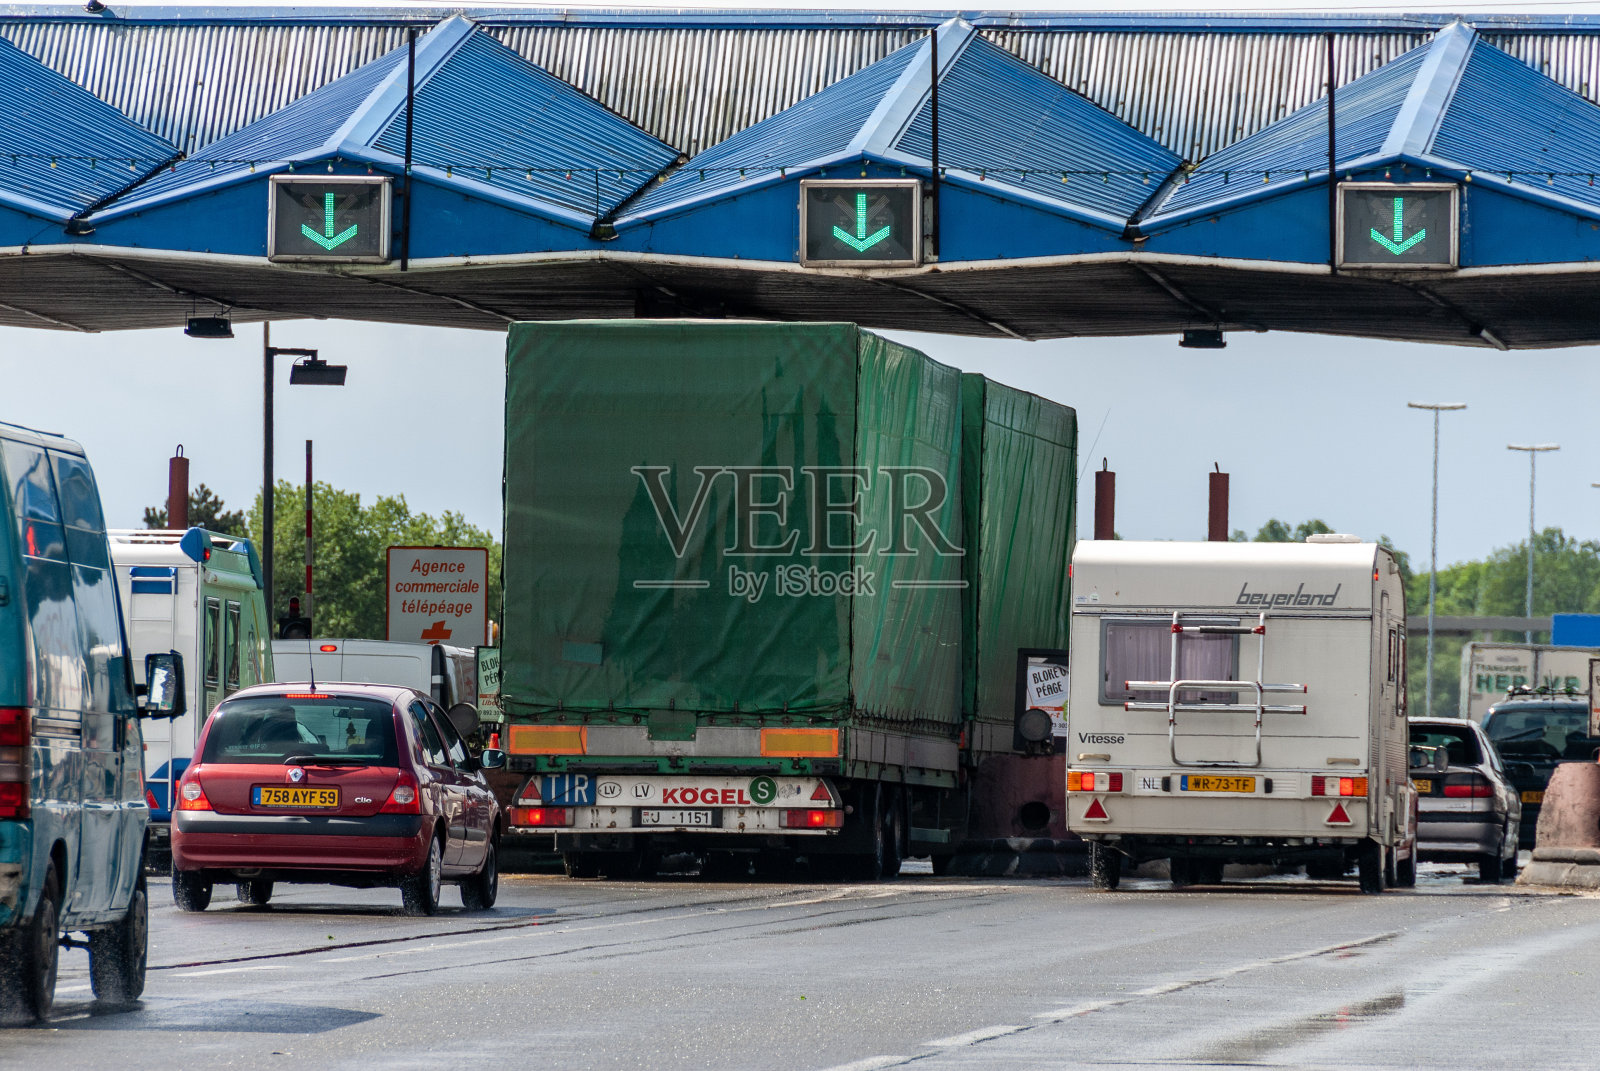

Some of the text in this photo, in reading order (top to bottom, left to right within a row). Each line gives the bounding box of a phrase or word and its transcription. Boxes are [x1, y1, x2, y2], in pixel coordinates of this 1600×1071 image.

[411, 559, 465, 576] Agence
[395, 579, 479, 593] commerciale
[1236, 582, 1342, 609] beyerland
[401, 599, 473, 617] télépéage
[481, 657, 500, 672] BLOK
[1036, 681, 1064, 697] PÉAGE
[1078, 733, 1125, 744] Vitesse
[547, 774, 588, 803] TIR
[604, 786, 615, 795] LV
[635, 785, 650, 798] LV
[757, 781, 769, 799] S
[1143, 778, 1158, 790] NL
[1193, 778, 1250, 791] WR-73-TF
[265, 790, 290, 803] 758
[292, 791, 317, 804] AYF
[319, 792, 336, 804] 59
[662, 787, 751, 805] KÖGEL
